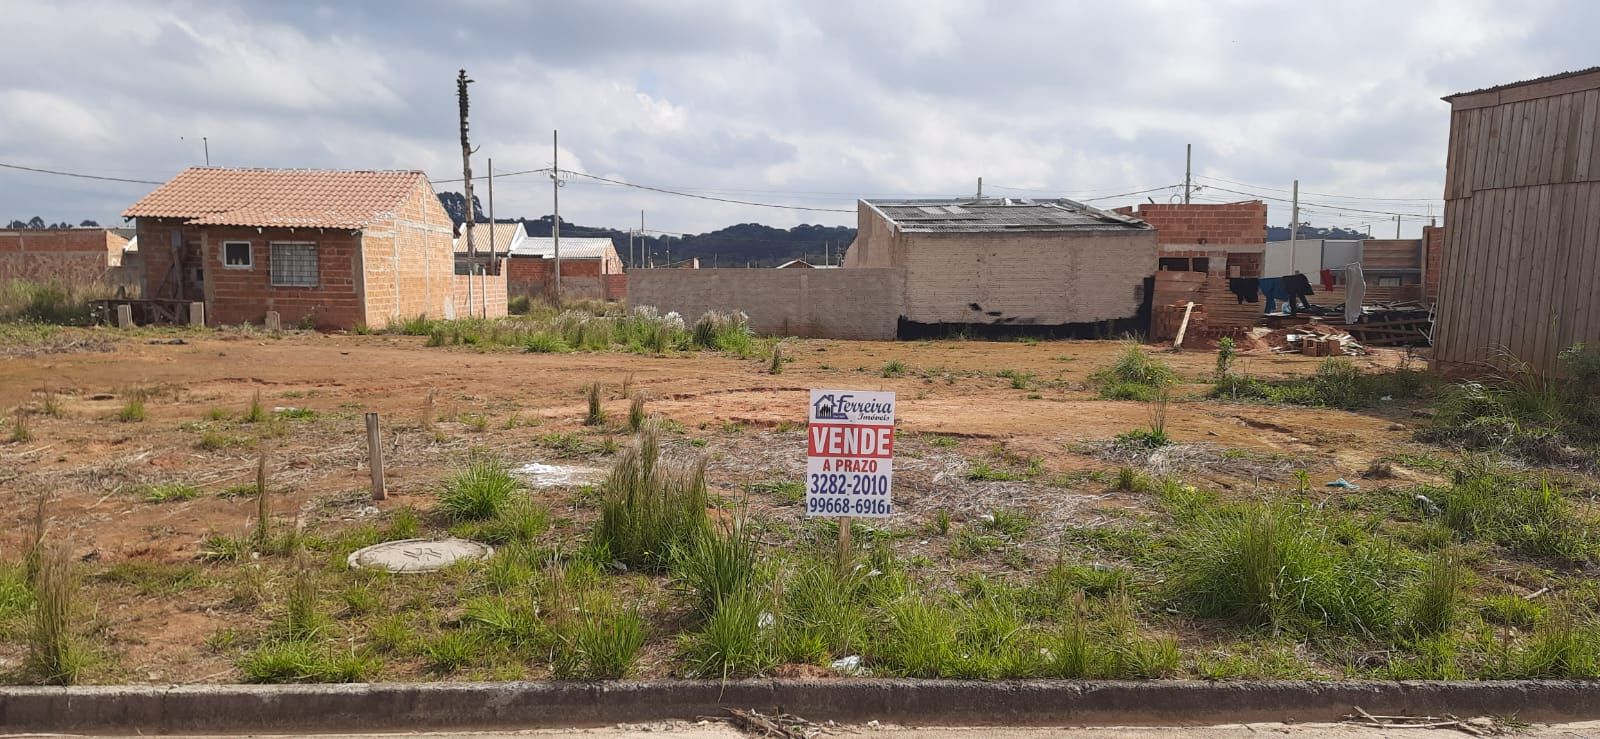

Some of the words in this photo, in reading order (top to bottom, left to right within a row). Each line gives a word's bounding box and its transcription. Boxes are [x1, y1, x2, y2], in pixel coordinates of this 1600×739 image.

[836, 395, 892, 413] Ferreira
[858, 413, 890, 421] Imóveis
[812, 427, 891, 455] VENDE
[823, 459, 831, 472] A
[835, 459, 878, 473] PRAZO
[810, 473, 888, 495] 3282-2010
[810, 497, 886, 514] 99668-6916
